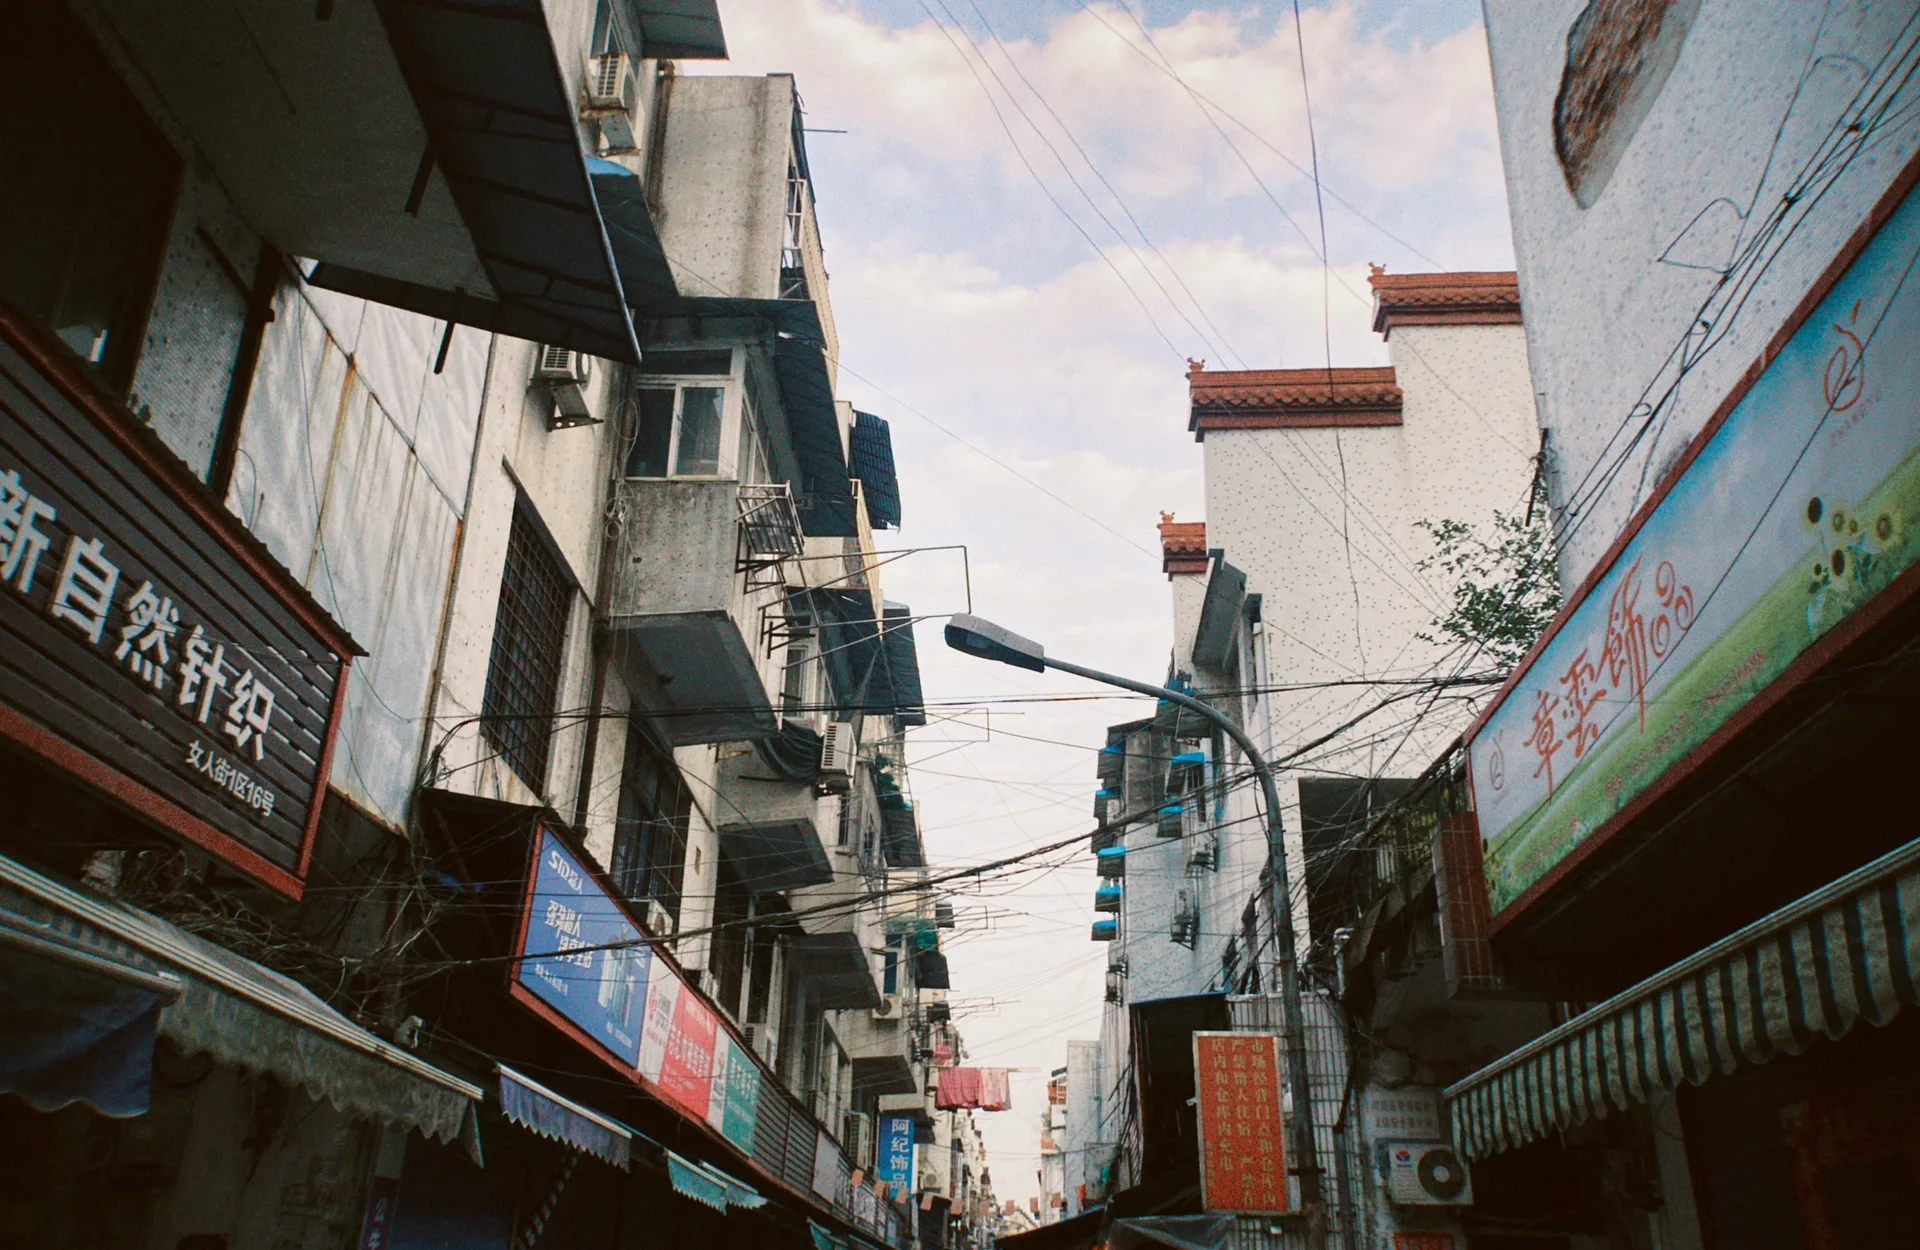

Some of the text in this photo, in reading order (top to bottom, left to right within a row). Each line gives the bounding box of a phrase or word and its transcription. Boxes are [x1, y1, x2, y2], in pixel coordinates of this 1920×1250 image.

[0, 468, 276, 762] 新自然针织
[185, 739, 276, 817] 女人街1区16号
[889, 1118, 911, 1190] 阿纪饰品
